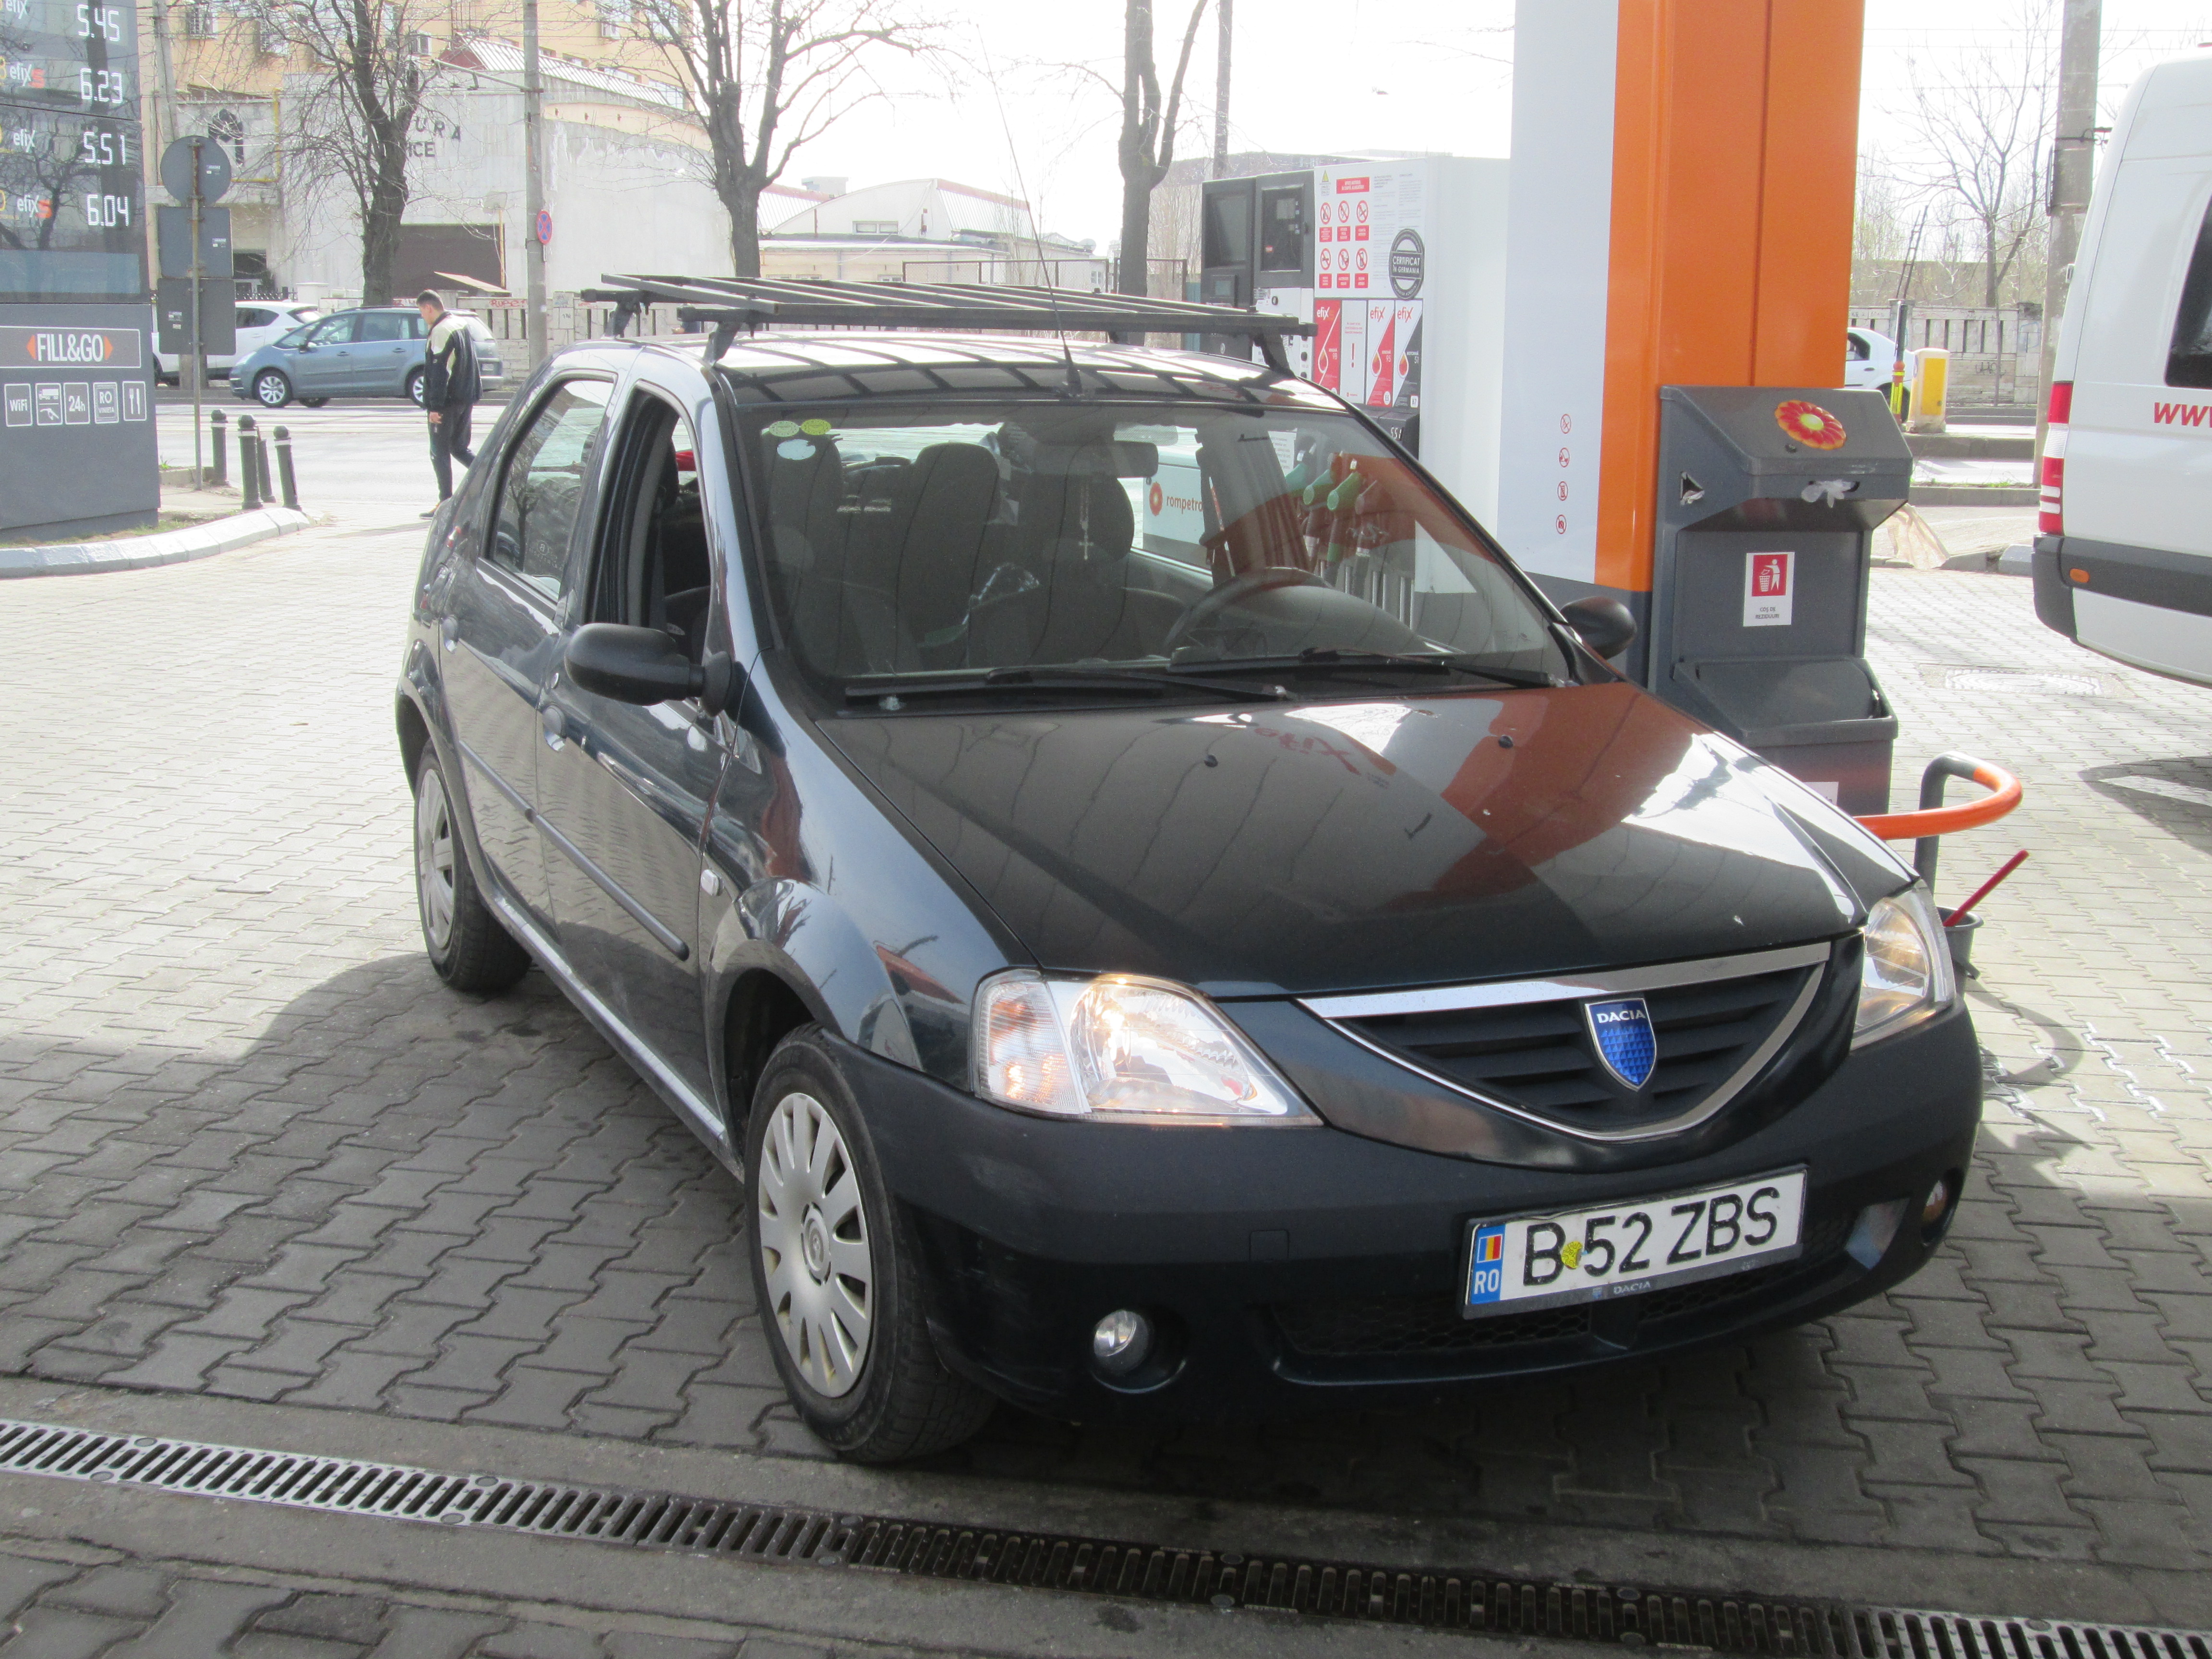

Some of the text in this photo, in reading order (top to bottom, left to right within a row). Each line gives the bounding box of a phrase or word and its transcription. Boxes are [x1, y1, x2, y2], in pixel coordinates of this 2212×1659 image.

[6, 0, 120, 41] efix 5.45
[80, 68, 123, 103] 6.23
[13, 129, 127, 165] efix 5.51
[87, 194, 129, 226] 6.04
[1393, 256, 1420, 265] CERTIFICAT
[1317, 306, 1330, 321] efix
[1370, 306, 1386, 322] efix
[1397, 307, 1414, 323] efix
[37, 333, 103, 362] FILL&GO
[10, 399, 27, 411] WiFi
[69, 396, 85, 412] 24h
[99, 391, 112, 404] RO
[2154, 402, 2212, 428] WW
[1166, 496, 1202, 514] rompetro
[1597, 1010, 1646, 1023] DACIA
[1523, 1222, 1566, 1286] B
[1584, 1212, 1653, 1277] 52
[1666, 1186, 1780, 1265] ZBS
[1474, 1269, 1501, 1294] RO
[1613, 1281, 1651, 1295] DACIA
